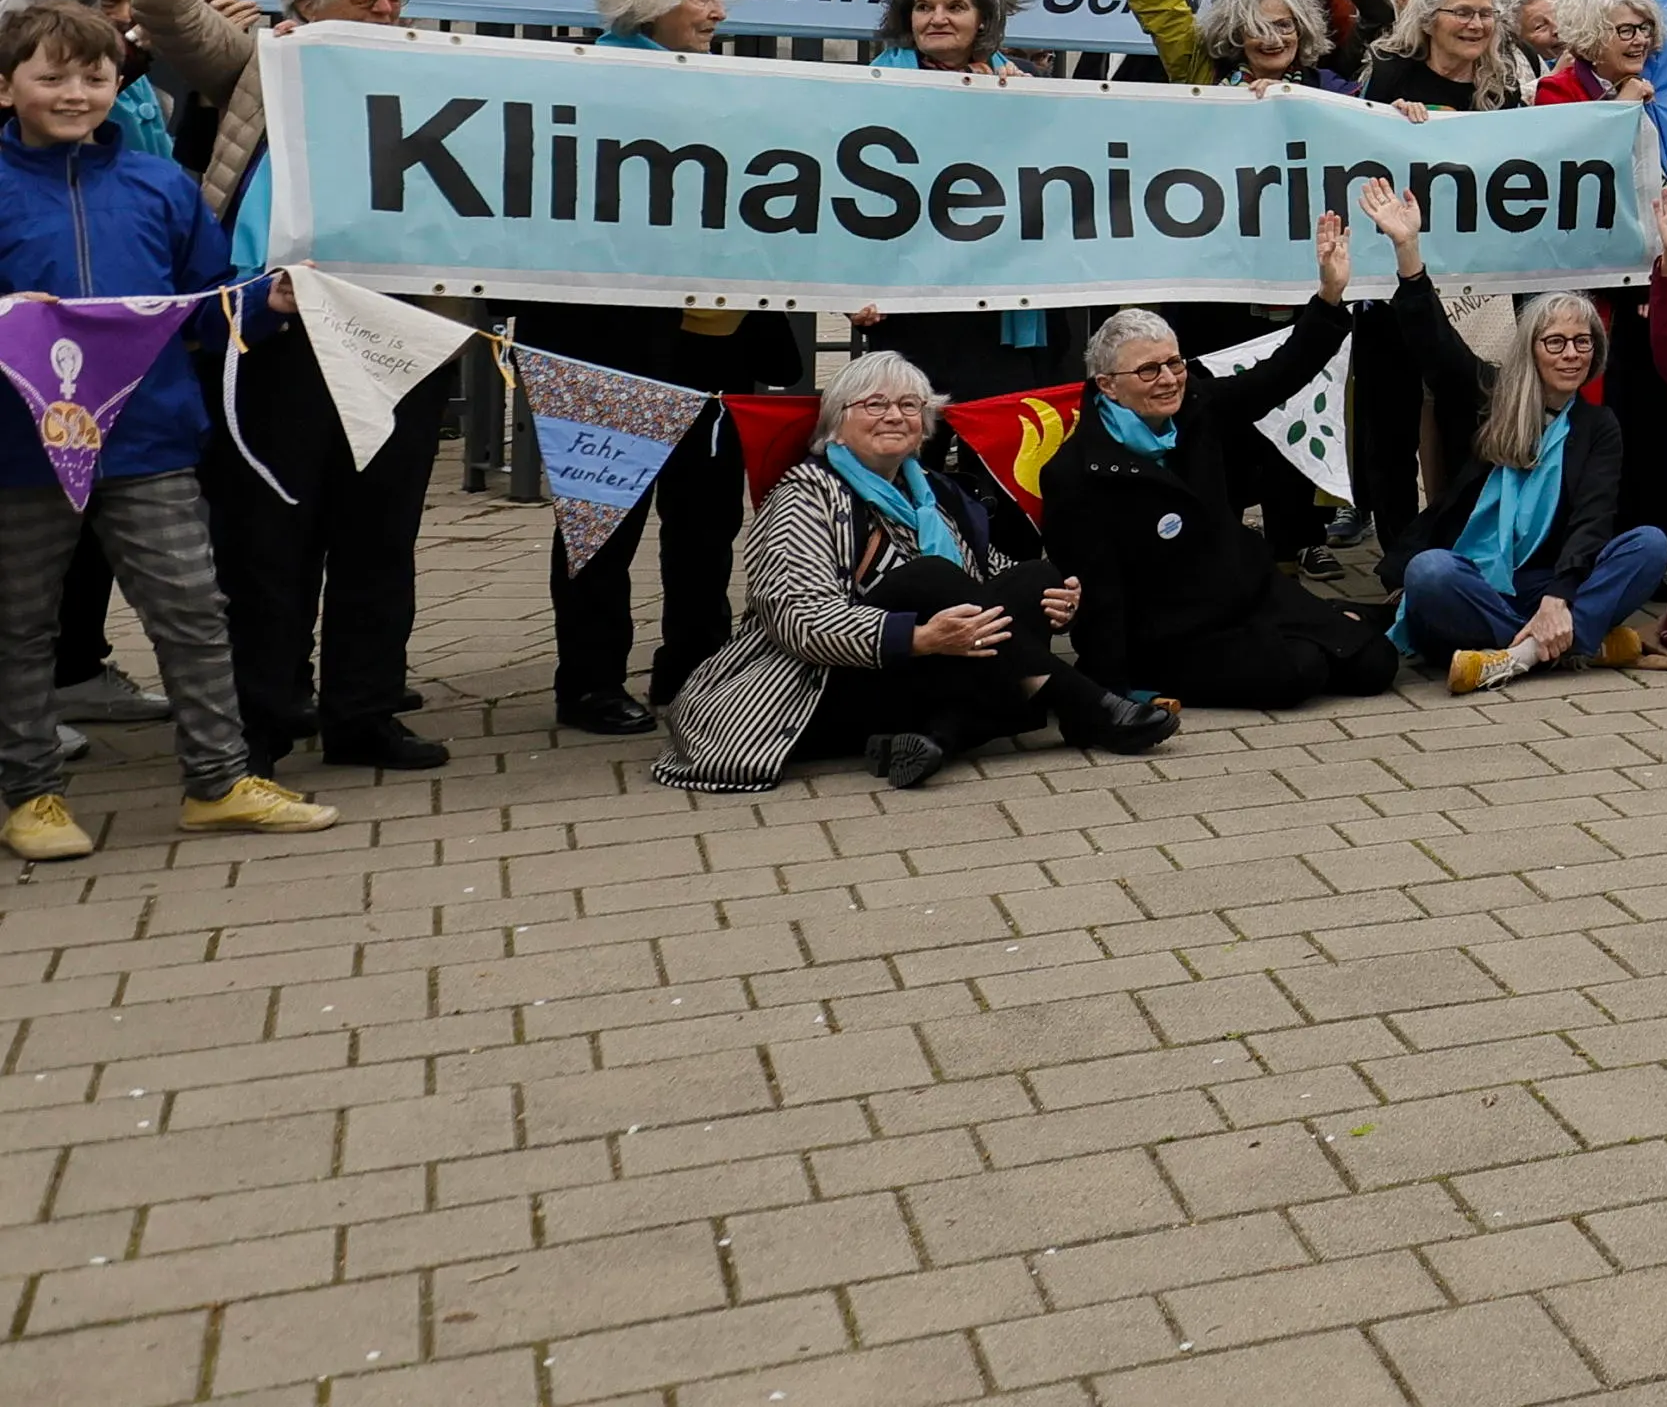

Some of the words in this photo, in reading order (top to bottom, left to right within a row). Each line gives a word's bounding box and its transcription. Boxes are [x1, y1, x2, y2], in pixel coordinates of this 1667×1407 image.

[366, 94, 1617, 242] KlimaSeniorinnen
[343, 311, 382, 345] time
[388, 335, 404, 350] is
[361, 348, 418, 374] accept
[567, 431, 626, 461] Fahr
